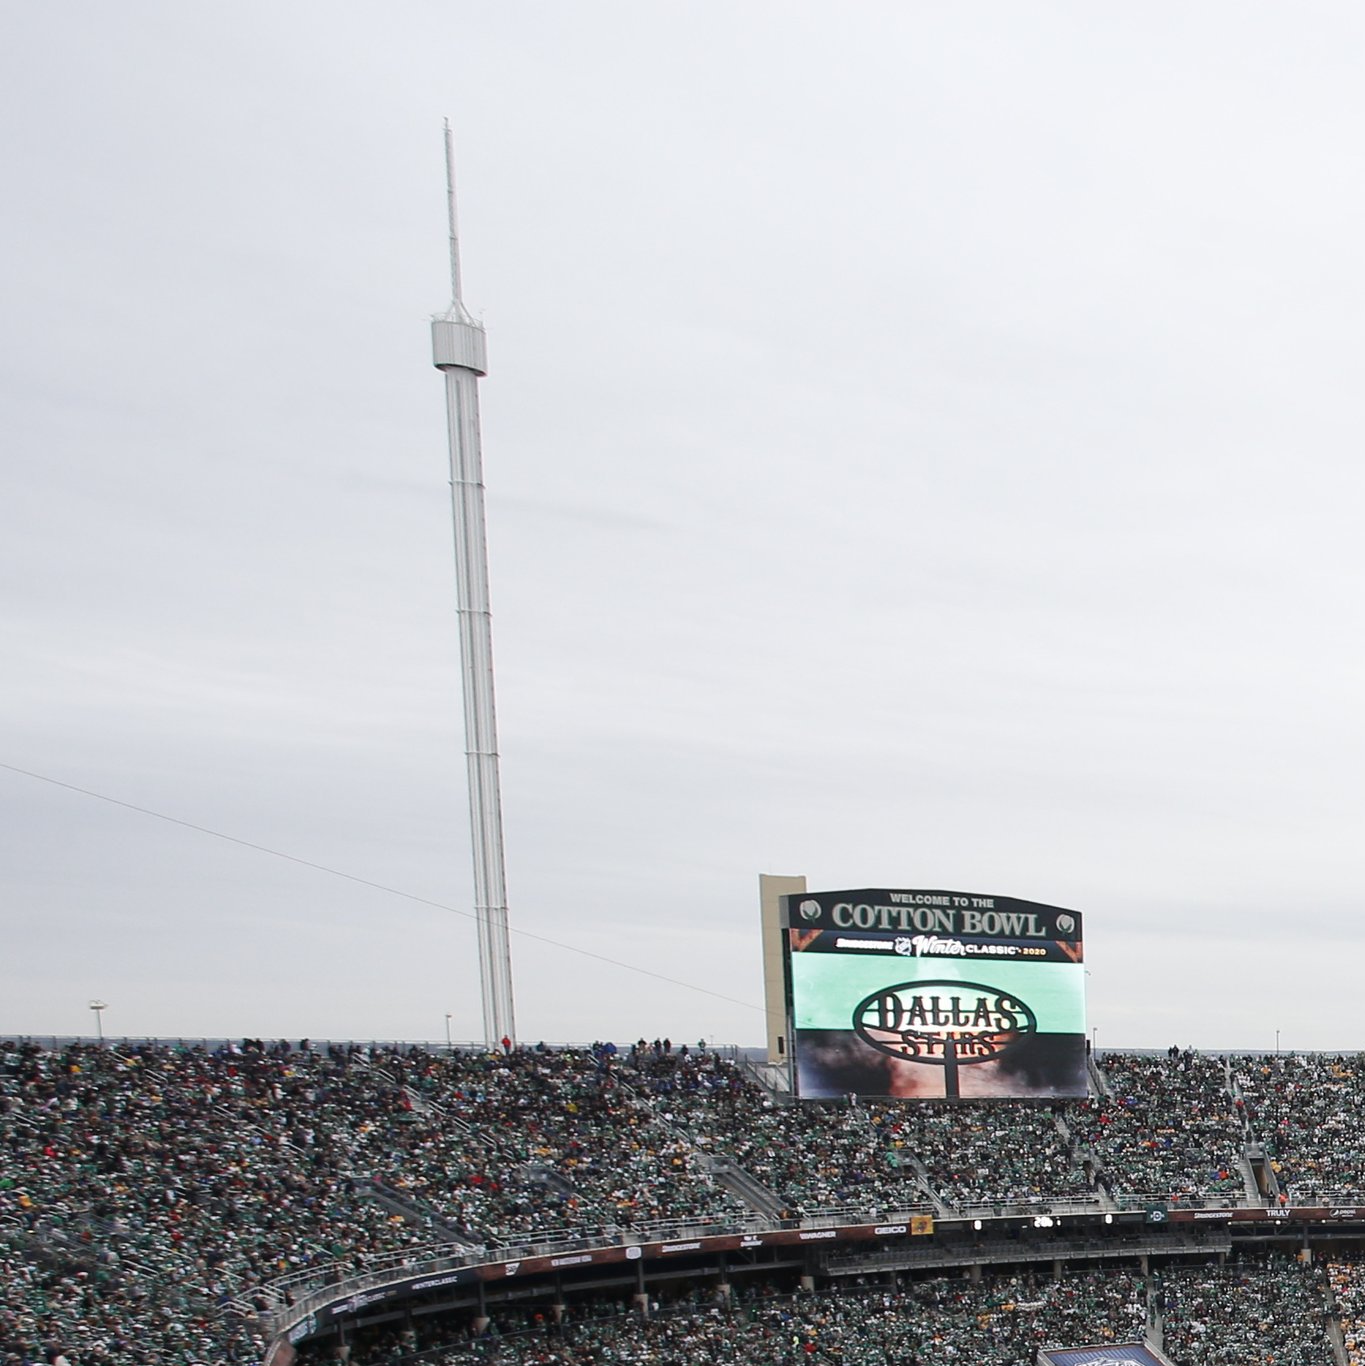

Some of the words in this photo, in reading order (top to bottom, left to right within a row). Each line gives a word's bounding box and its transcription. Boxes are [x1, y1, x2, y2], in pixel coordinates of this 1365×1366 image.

[889, 892, 950, 907] WELCOME
[952, 896, 969, 907] TO
[971, 897, 995, 909] THE
[832, 903, 954, 933] COTTON
[962, 910, 1046, 937] BOWL
[911, 934, 967, 958] Winter
[966, 943, 1016, 956] CLASSIC
[1022, 947, 1047, 956] 2020
[878, 992, 1021, 1030] DALLAS
[1265, 1209, 1291, 1218] TRULY
[874, 1225, 906, 1235] GEICO
